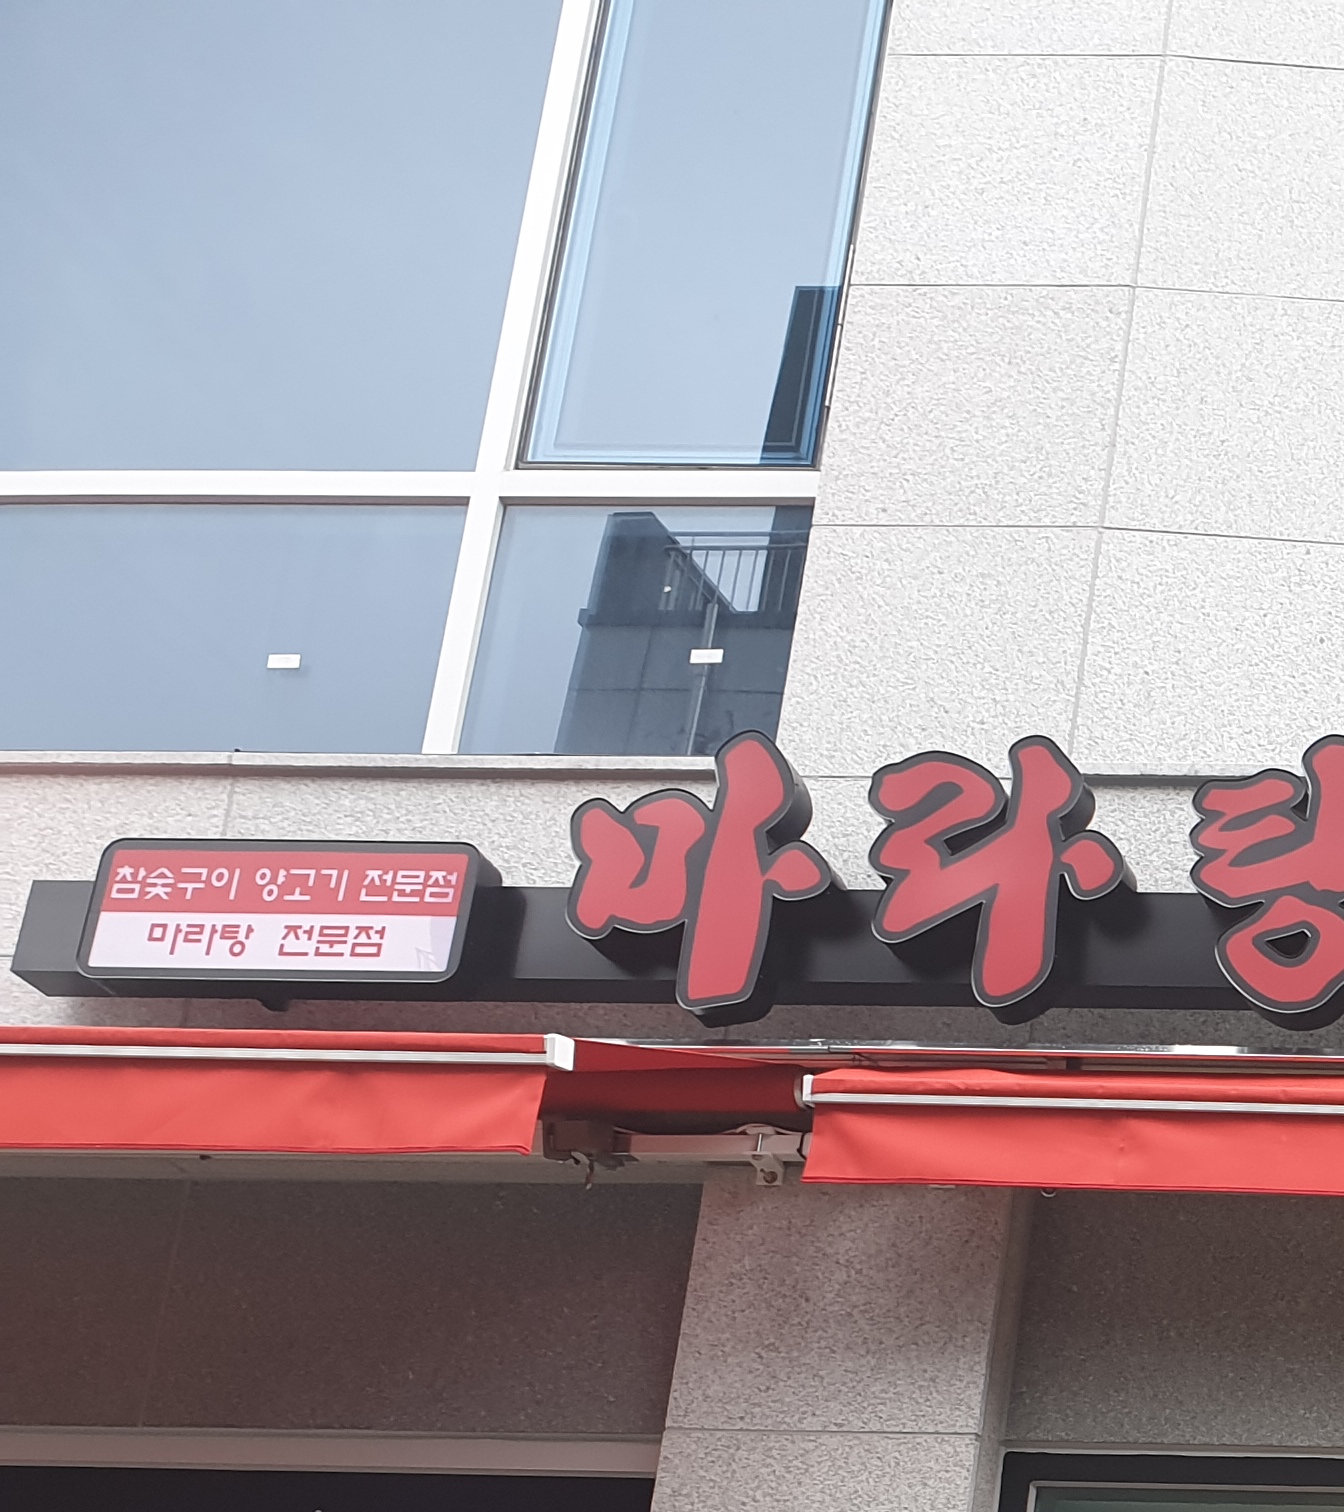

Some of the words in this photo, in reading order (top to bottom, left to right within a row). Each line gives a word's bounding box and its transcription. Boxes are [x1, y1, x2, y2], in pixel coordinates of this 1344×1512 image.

[109, 864, 241, 901] 참숯구이
[254, 867, 350, 902] 양고기
[358, 868, 458, 903] 전문점
[146, 922, 255, 958] 마라탕
[277, 923, 387, 958] 전문점
